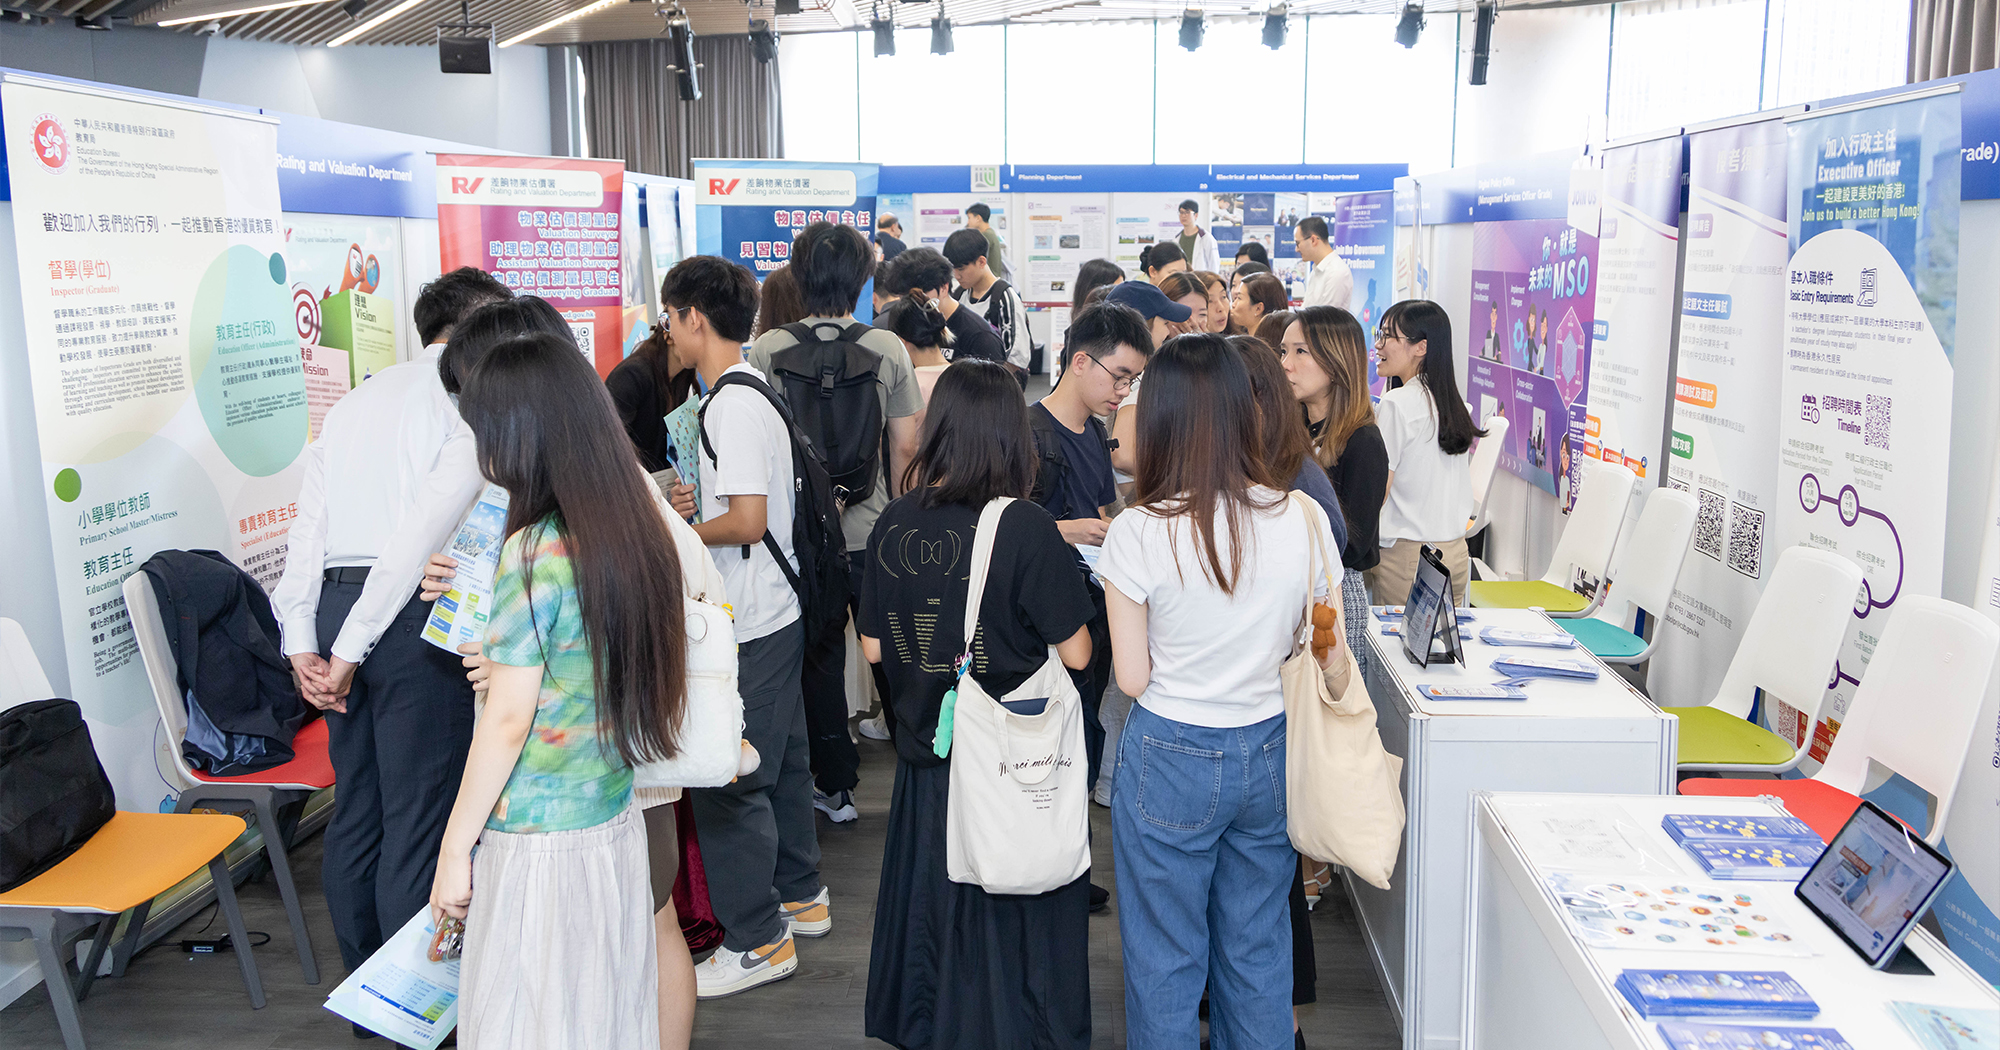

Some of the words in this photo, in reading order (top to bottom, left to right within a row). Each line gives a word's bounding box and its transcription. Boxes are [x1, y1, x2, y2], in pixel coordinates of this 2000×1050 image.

[75, 133, 96, 144] 教育局
[1824, 128, 1897, 161] 加入行政主任
[77, 146, 102, 156] Education
[103, 148, 120, 157] Bureau
[1961, 141, 2000, 164] rade)
[89, 158, 117, 167] Government
[132, 162, 144, 170] Hong
[146, 162, 157, 171] Kong
[159, 163, 174, 172] Special
[204, 166, 218, 175] Region
[116, 169, 134, 178] Republic
[276, 153, 306, 174] Rating
[309, 159, 325, 173] and
[328, 159, 367, 177] Valuation
[369, 165, 412, 182] Department
[1818, 159, 1865, 183] Executive
[1866, 157, 1901, 177] Officer
[490, 177, 556, 188] 差餉物業估價署
[746, 178, 810, 188] 差餉物業估價署
[1503, 176, 1515, 186] Office
[490, 187, 512, 196] Rating
[528, 188, 558, 196] Valuation
[559, 189, 596, 198] Department
[746, 188, 766, 196] Rating
[813, 189, 850, 197] Department
[1504, 192, 1521, 202] Services
[1522, 191, 1536, 201] Officer
[1538, 189, 1552, 200] Grade)
[1572, 190, 1587, 205] JOIN
[1588, 189, 1597, 205] US
[518, 211, 618, 227] 物業估價測量師
[775, 210, 870, 226] 物業估價主任
[1803, 209, 1815, 222] Join
[1817, 211, 1824, 221] us
[1826, 208, 1834, 221] to
[1835, 207, 1851, 220] build
[1852, 209, 1857, 219] a
[1858, 205, 1880, 219] better
[1882, 205, 1897, 221] Hong
[1899, 202, 1920, 220] Kong!
[538, 228, 579, 239] Valuation
[581, 229, 618, 240] Surveyor
[490, 241, 619, 256] 助理物業估價測量師
[740, 242, 792, 257] 見習物
[48, 260, 111, 281] 督學(學位)
[497, 258, 538, 268] Assistant
[539, 258, 581, 268] Valuation
[583, 259, 619, 270] Surveyor
[491, 271, 619, 286] 物業估價測量見習生
[51, 286, 84, 298] Inspector
[86, 285, 119, 295] (Graduate)
[514, 289, 535, 297] ation
[537, 287, 581, 299] Surveying
[583, 287, 619, 297] Graduate
[1802, 290, 1814, 304] Entry
[1816, 291, 1854, 305] Requirements
[355, 308, 376, 323] Vision
[216, 320, 276, 341] 教育主任(行政)
[218, 344, 240, 355] Education
[1822, 395, 1862, 417] 招聘時間表
[1837, 418, 1861, 435] Timeline
[78, 492, 150, 529] 小學學位教師
[239, 502, 298, 534] 專責教育主任
[80, 532, 107, 546] Primary
[109, 523, 128, 537] School
[240, 536, 263, 550] Specialist
[84, 546, 134, 580] 教育主任
[85, 577, 118, 595] Education
[1943, 918, 1964, 938] General
[1964, 933, 1984, 952] Grades
[1984, 947, 2000, 963] Offic
